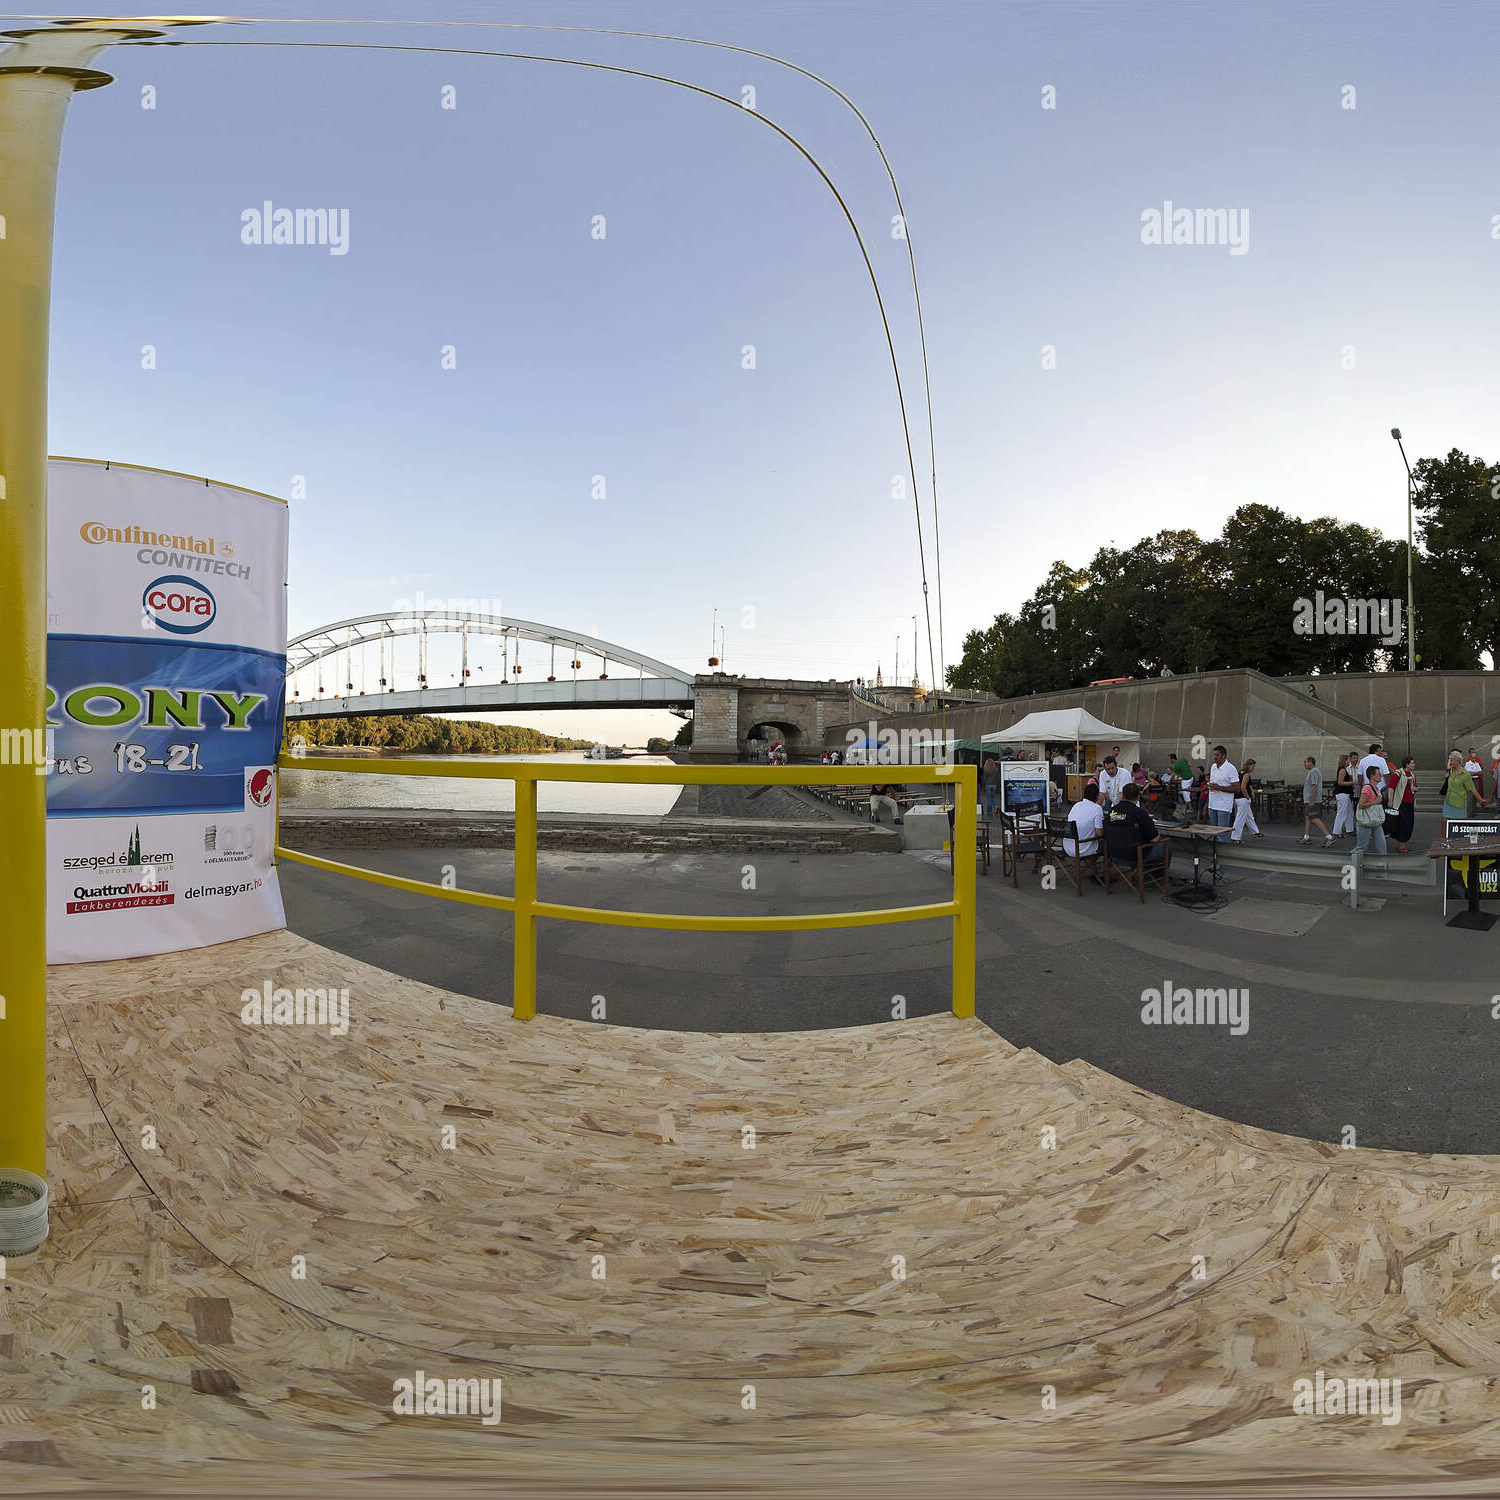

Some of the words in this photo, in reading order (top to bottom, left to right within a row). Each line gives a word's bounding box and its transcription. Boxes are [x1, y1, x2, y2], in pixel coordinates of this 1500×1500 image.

[80, 521, 215, 555] Continental
[136, 548, 251, 579] CONTITECH
[148, 591, 211, 615] cora
[114, 742, 203, 774] 18-21.
[1451, 825, 1459, 833] JÓ
[63, 852, 115, 870] szeged
[157, 865, 174, 873] pub
[73, 880, 169, 900] QuattroMobili
[184, 878, 263, 899] delmagyar.hu
